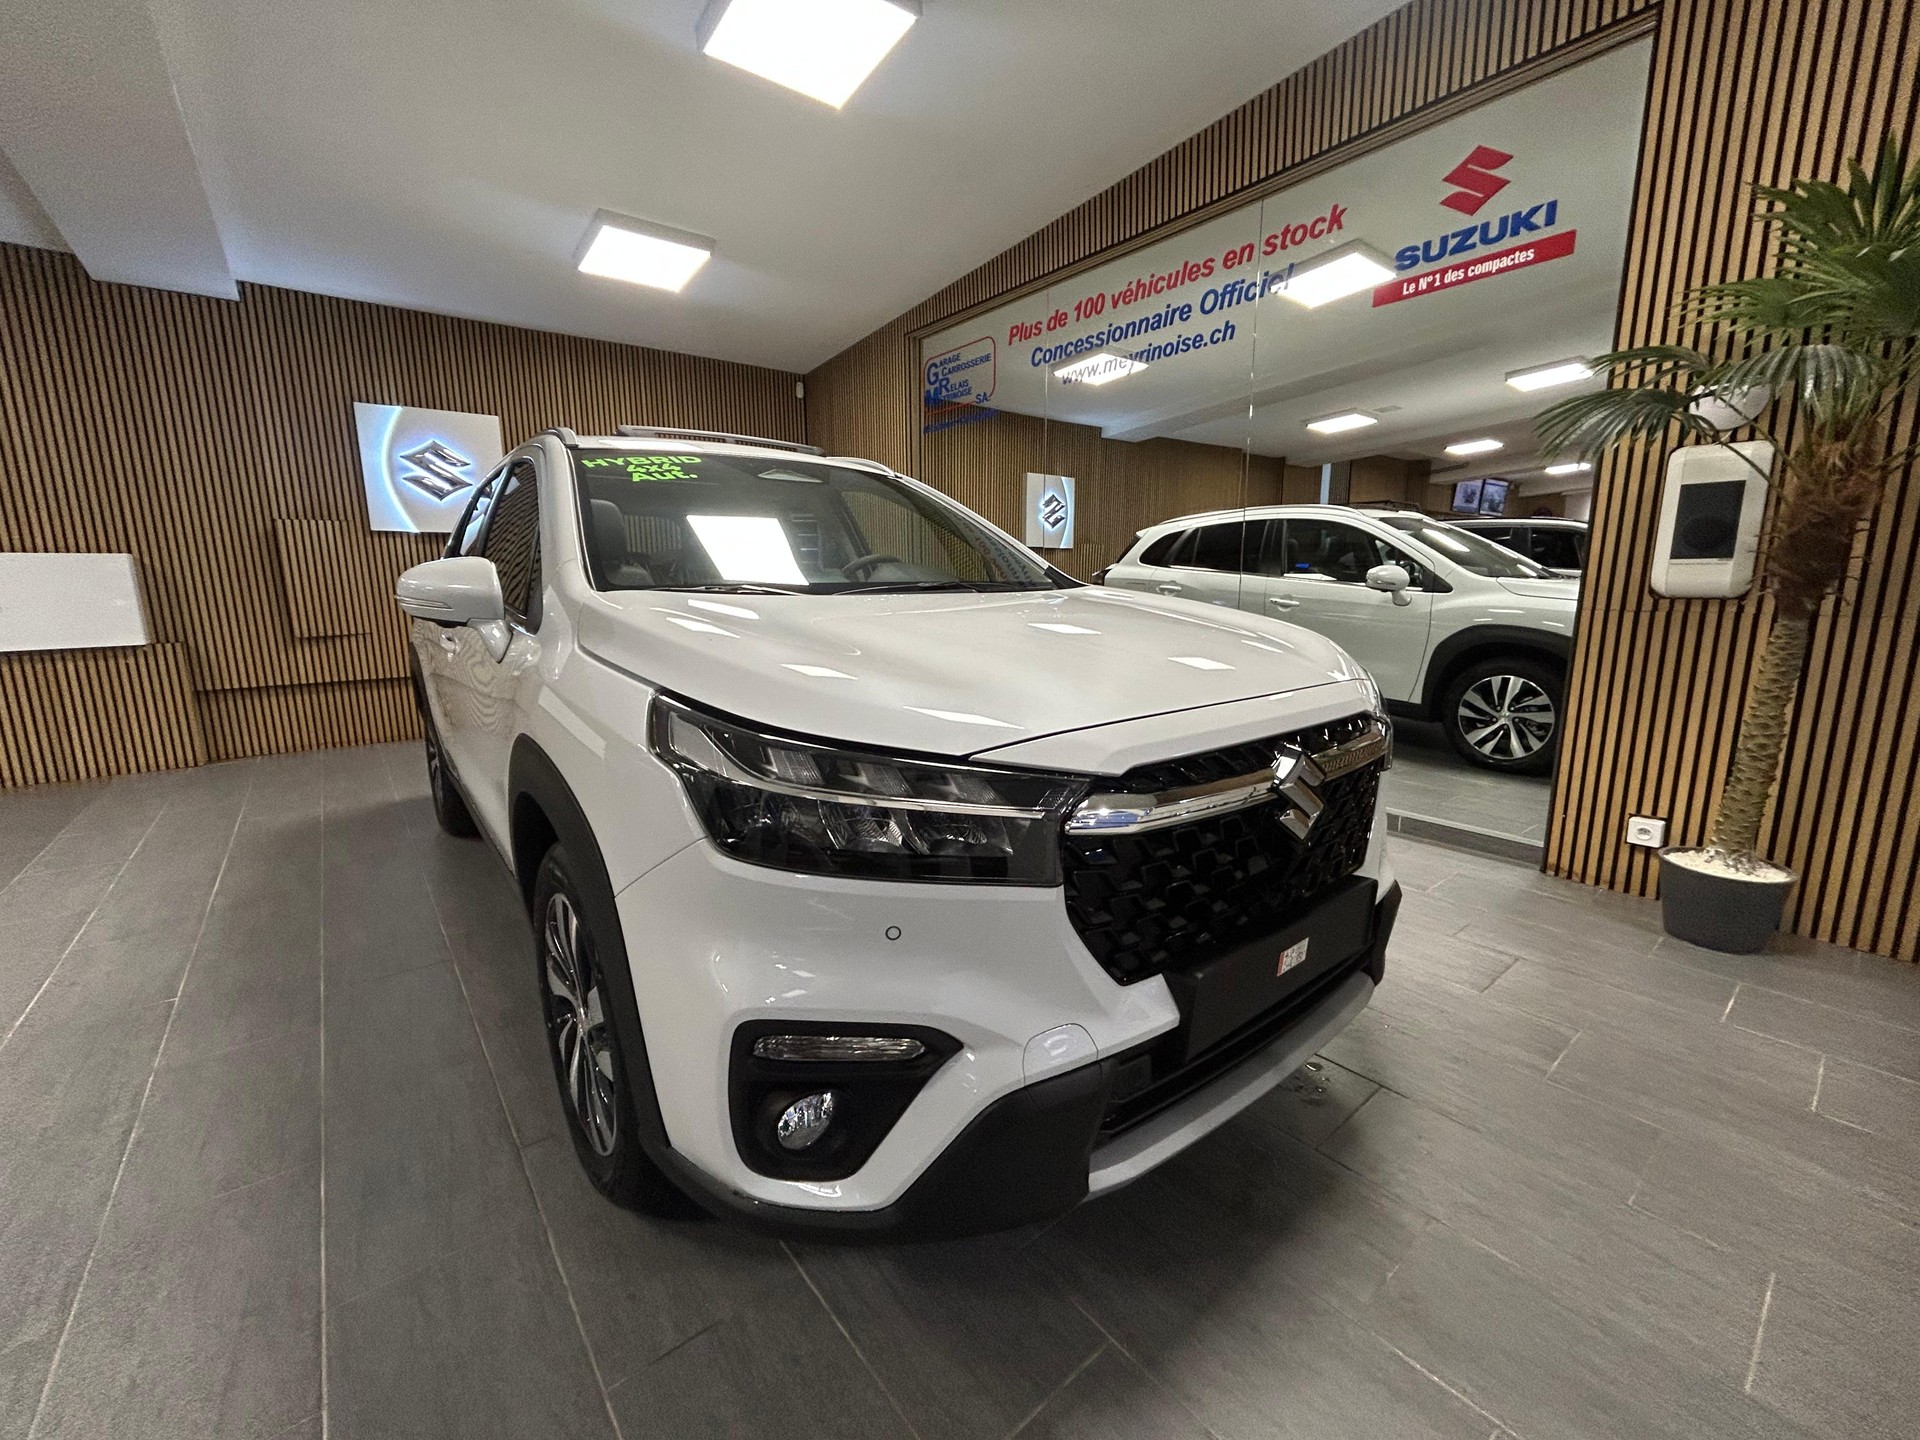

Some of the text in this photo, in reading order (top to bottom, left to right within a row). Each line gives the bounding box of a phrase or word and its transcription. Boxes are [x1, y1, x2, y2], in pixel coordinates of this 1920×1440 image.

[1394, 199, 1558, 271] SUZUKI
[1008, 203, 1348, 346] Plus de 100 véhicules en stock
[1402, 282, 1415, 295] Le
[1444, 269, 1464, 284] des
[1467, 248, 1535, 276] compactes
[1030, 262, 1295, 368] Concessionnaire Officiel
[941, 353, 992, 377] CARROSSERIE
[1062, 320, 1236, 385] www.meyrinoise.ch
[581, 456, 702, 468] HYBRID
[626, 463, 681, 473] 4x4
[632, 470, 698, 482] Aut.
